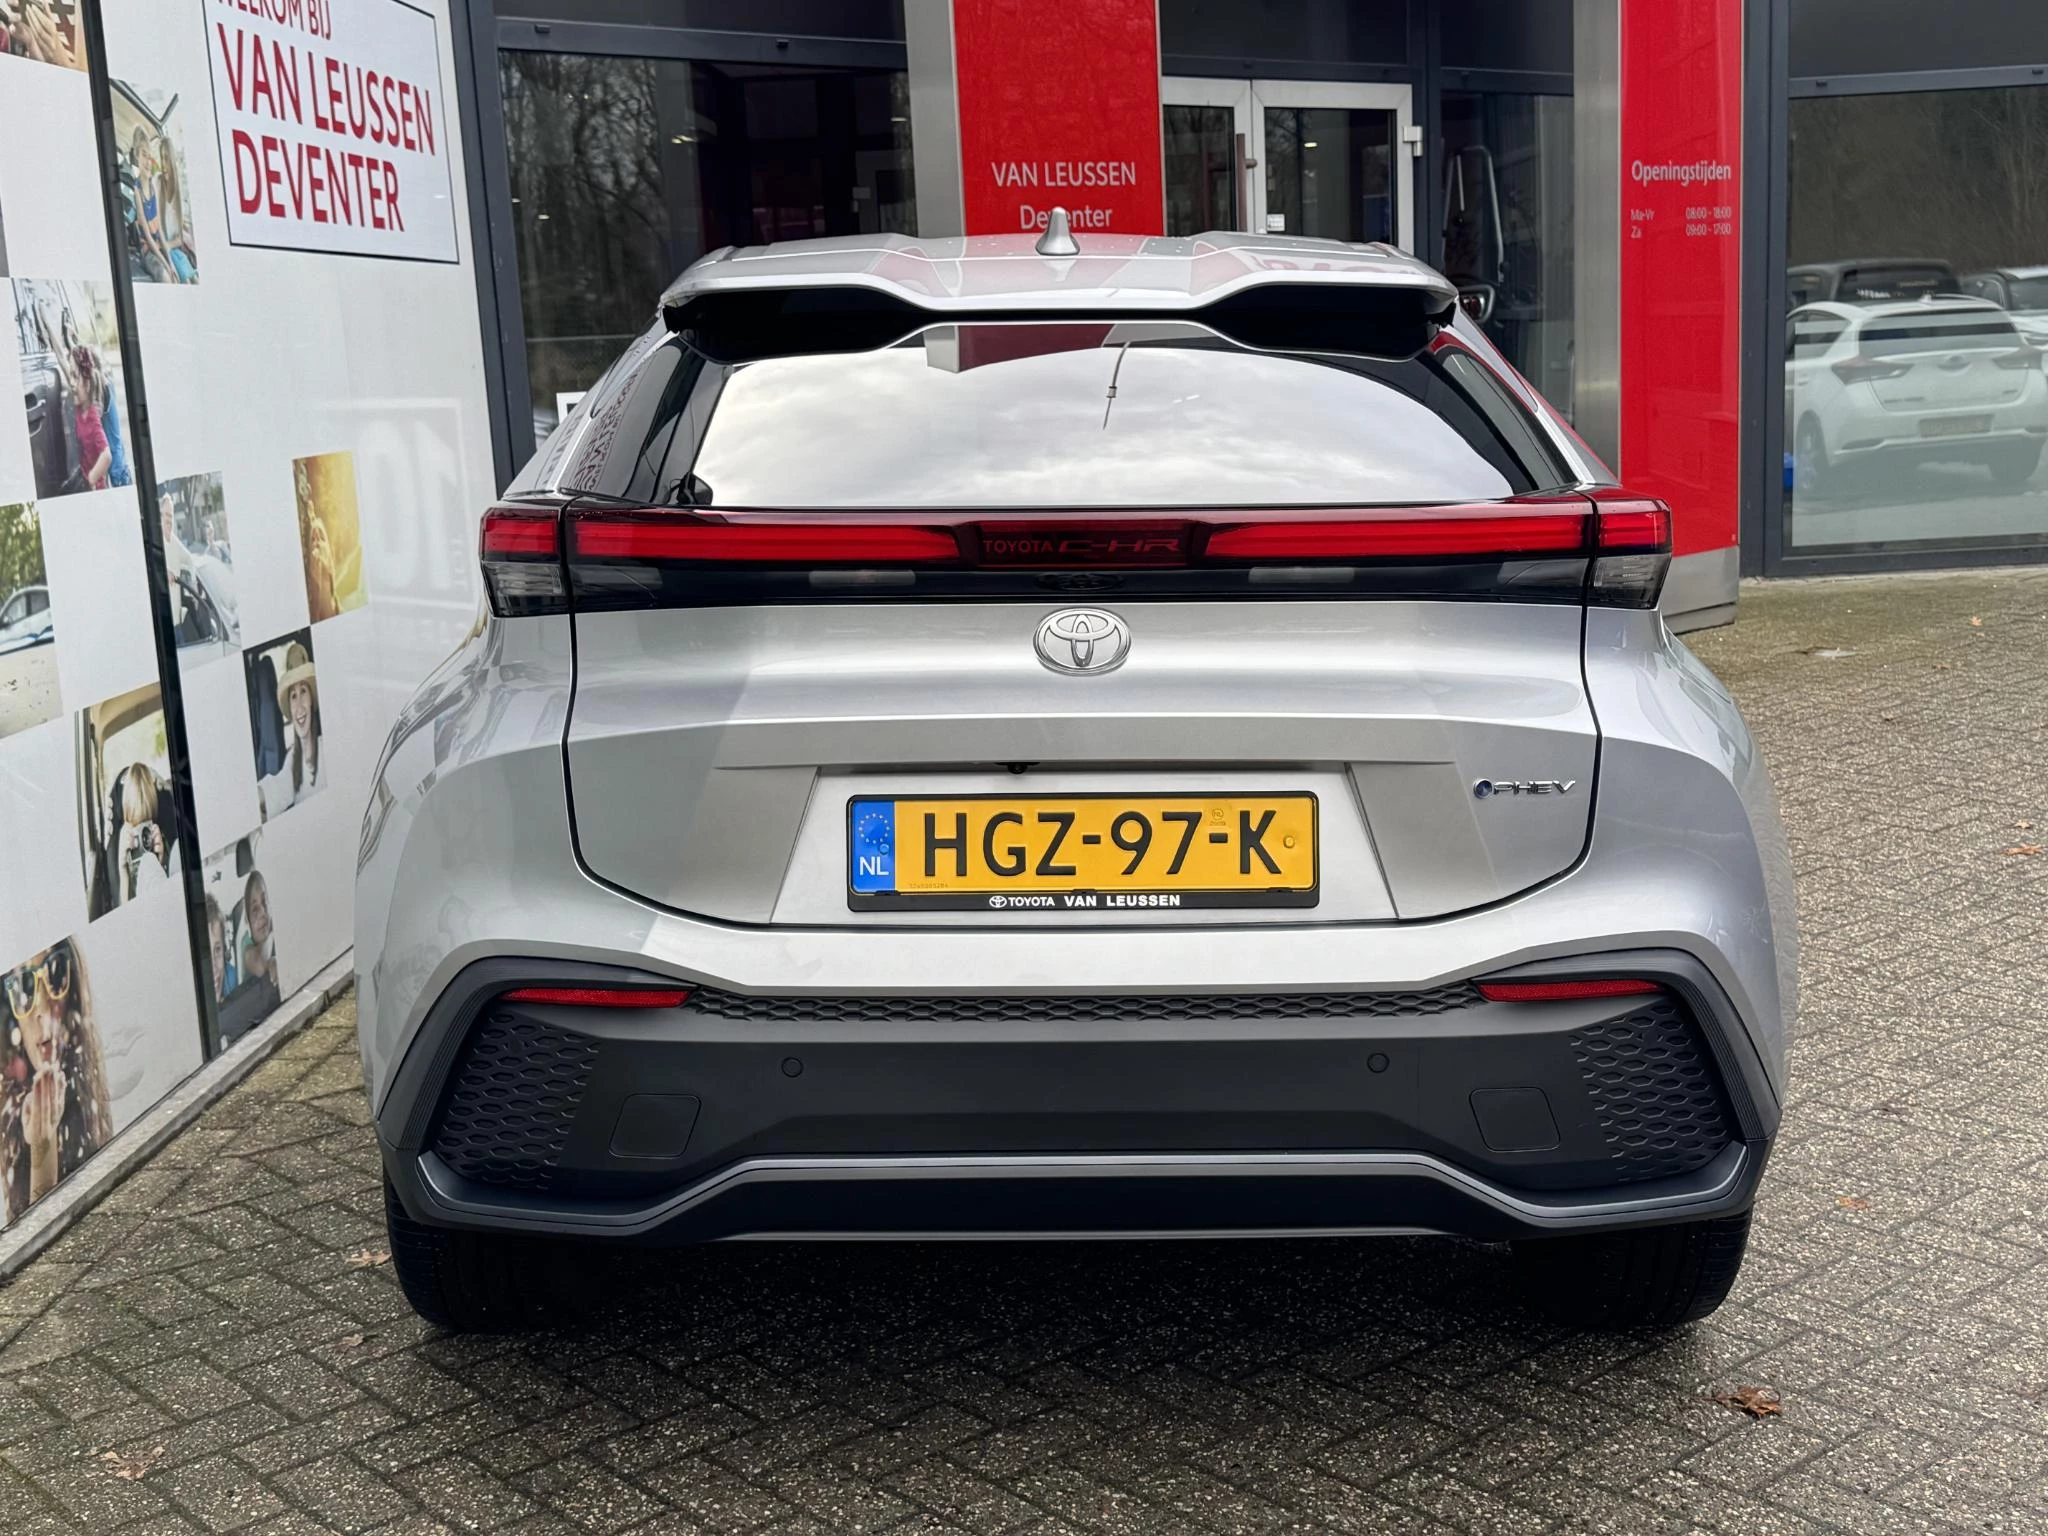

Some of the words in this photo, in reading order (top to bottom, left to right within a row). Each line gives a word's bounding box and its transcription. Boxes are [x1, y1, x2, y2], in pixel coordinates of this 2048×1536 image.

[217, 0, 304, 32] LKOM
[308, 0, 331, 40] BIJ
[217, 22, 303, 125] VAN
[308, 51, 436, 156] LEUSSEN
[231, 129, 405, 232] DEVENTER
[991, 161, 1038, 187] VAN
[1044, 161, 1136, 187] LEUSSEN
[1631, 160, 1731, 187] Openingstijden
[1019, 204, 1113, 230] Denter
[983, 540, 1053, 554] TOYOTA
[1058, 540, 1180, 553] C-HR
[1493, 780, 1577, 795] PHEV
[924, 810, 1282, 877] HGZ-97-K
[859, 856, 889, 876] NL
[1008, 896, 1055, 907] TOYOTA
[1064, 895, 1097, 907] VAN
[1106, 894, 1181, 907] LEUSSEN
